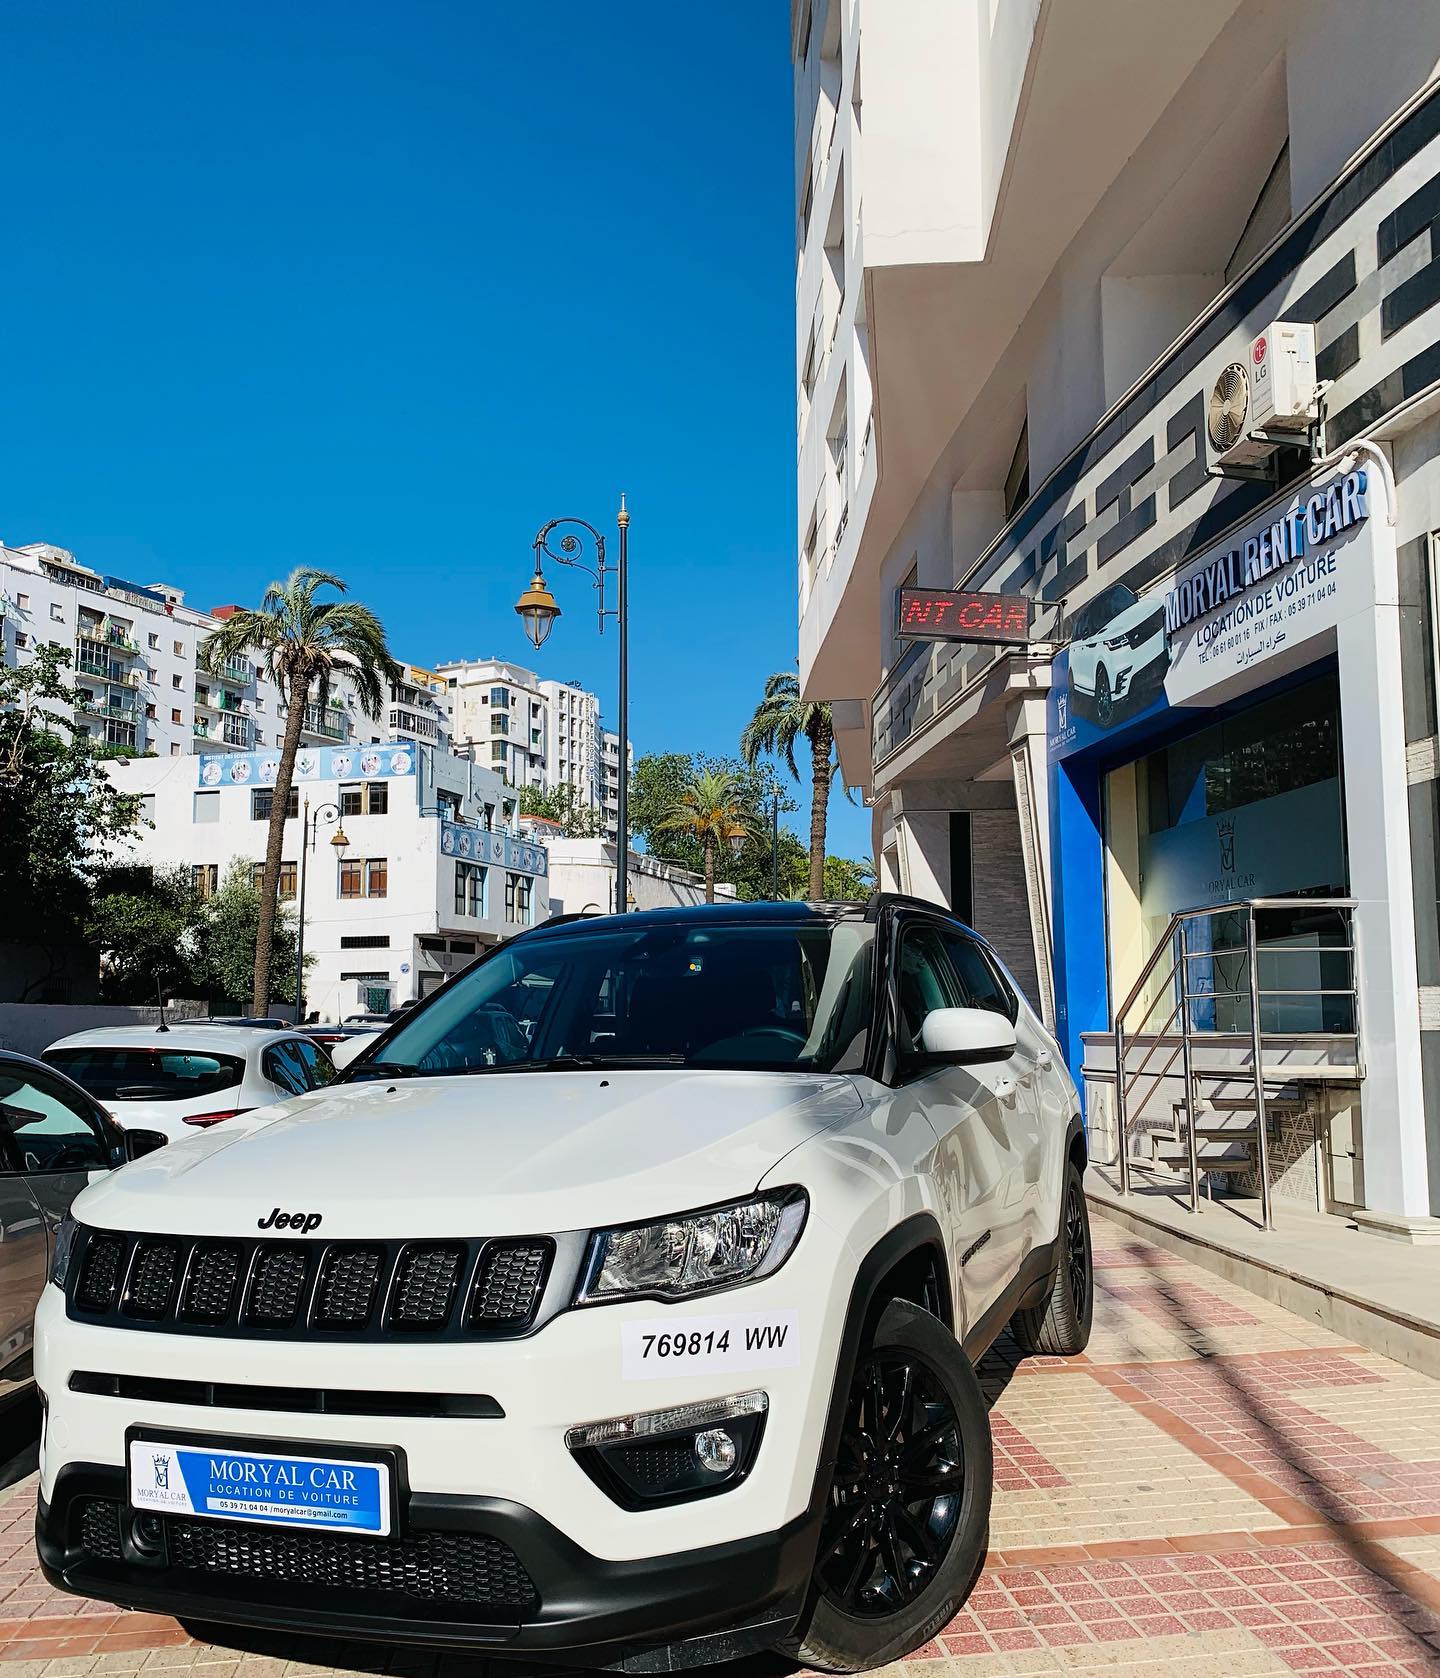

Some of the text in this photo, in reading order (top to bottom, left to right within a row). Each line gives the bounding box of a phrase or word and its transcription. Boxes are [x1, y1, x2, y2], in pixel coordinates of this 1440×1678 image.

[1255, 364, 1267, 384] LG
[1165, 470, 1369, 634] MORYAL RENT CAR
[903, 598, 1027, 630] NT CAR
[1197, 551, 1337, 647] LOCATION DE VOITURE
[1199, 651, 1209, 664] TEL
[1254, 620, 1265, 634] FIX
[1270, 609, 1283, 627] FAX
[1288, 604, 1297, 617] 05
[1298, 597, 1306, 612] 39
[1307, 592, 1315, 607] 71
[1318, 585, 1326, 601] 04
[1327, 581, 1336, 596] 04
[1237, 873, 1256, 888] CAR
[257, 1207, 322, 1235] Jeep
[641, 1324, 789, 1359] 769814 WW
[209, 1459, 358, 1491] MORYAL CAR
[137, 1488, 186, 1502] MORYAL CAR
[209, 1483, 360, 1506] LOCATION DE VOITURE
[220, 1500, 228, 1508] 05
[230, 1501, 238, 1509] 39
[239, 1502, 247, 1510] 71
